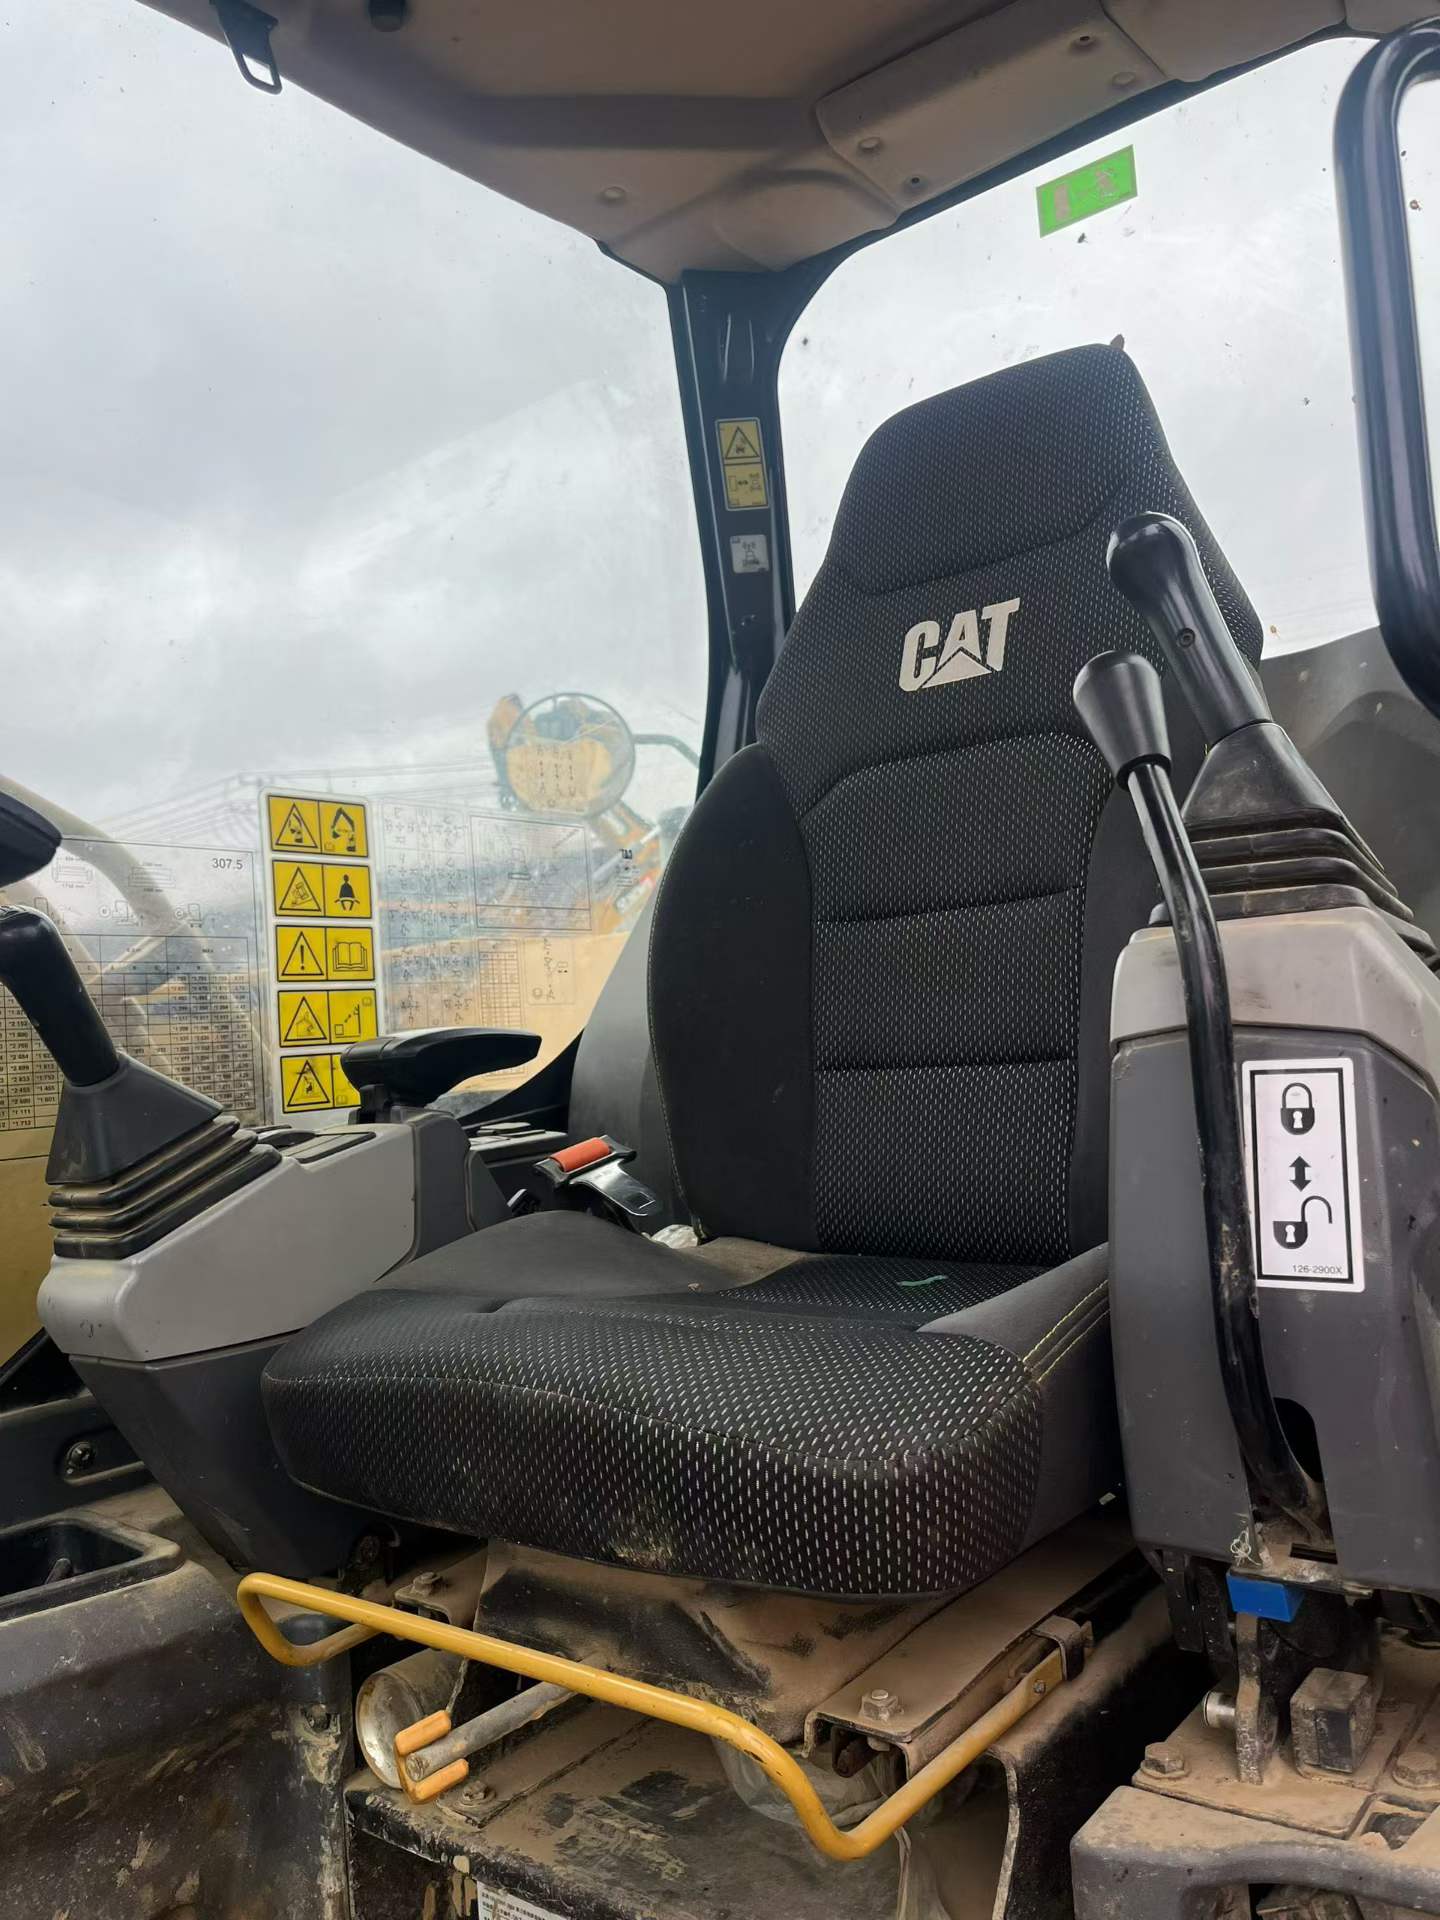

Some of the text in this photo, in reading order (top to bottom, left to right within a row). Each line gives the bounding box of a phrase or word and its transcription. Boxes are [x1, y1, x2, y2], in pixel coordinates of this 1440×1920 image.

[898, 597, 1021, 692] CAT
[212, 857, 243, 870] 307.5
[1293, 1264, 1342, 1275] 126-2900X
